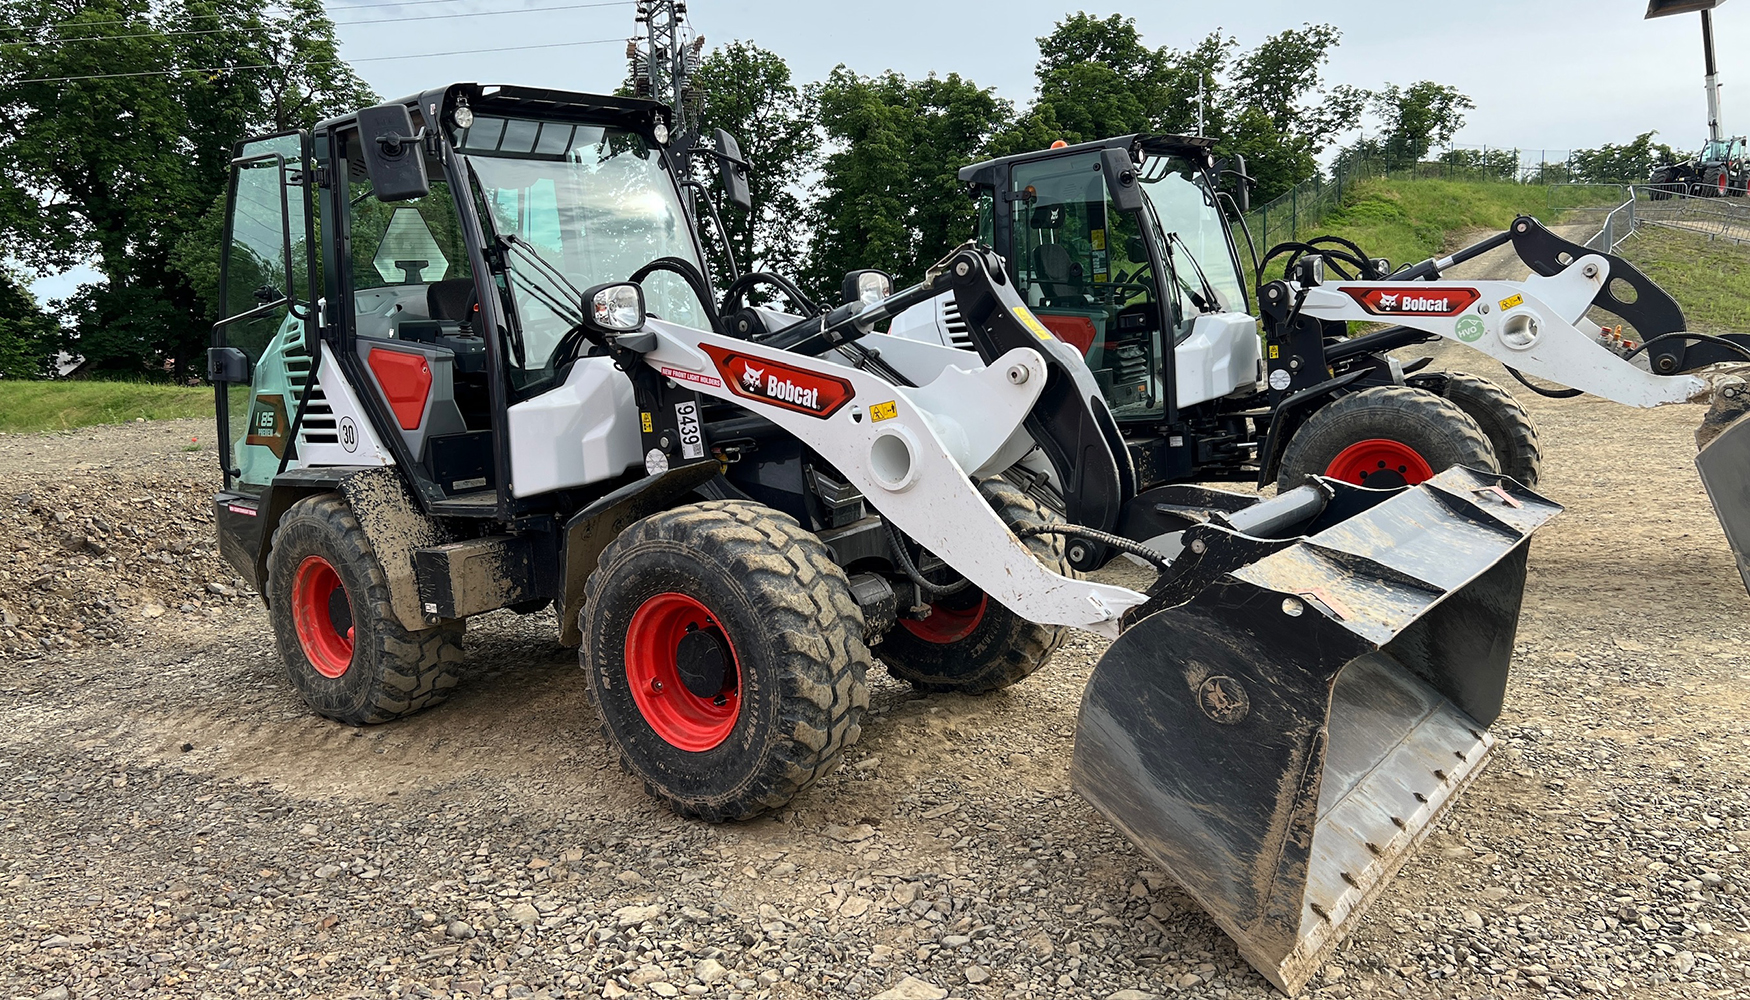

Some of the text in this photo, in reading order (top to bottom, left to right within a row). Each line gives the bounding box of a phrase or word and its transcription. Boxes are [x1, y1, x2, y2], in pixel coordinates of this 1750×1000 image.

[1402, 296, 1448, 312] Bobcat
[1458, 326, 1477, 338] HVO
[673, 370, 686, 379] FRONT
[687, 373, 699, 382] LIGHT
[700, 375, 720, 387] HOLDERS
[767, 374, 818, 409] Bobcat
[342, 424, 355, 445] 30
[677, 405, 700, 445] 9439
